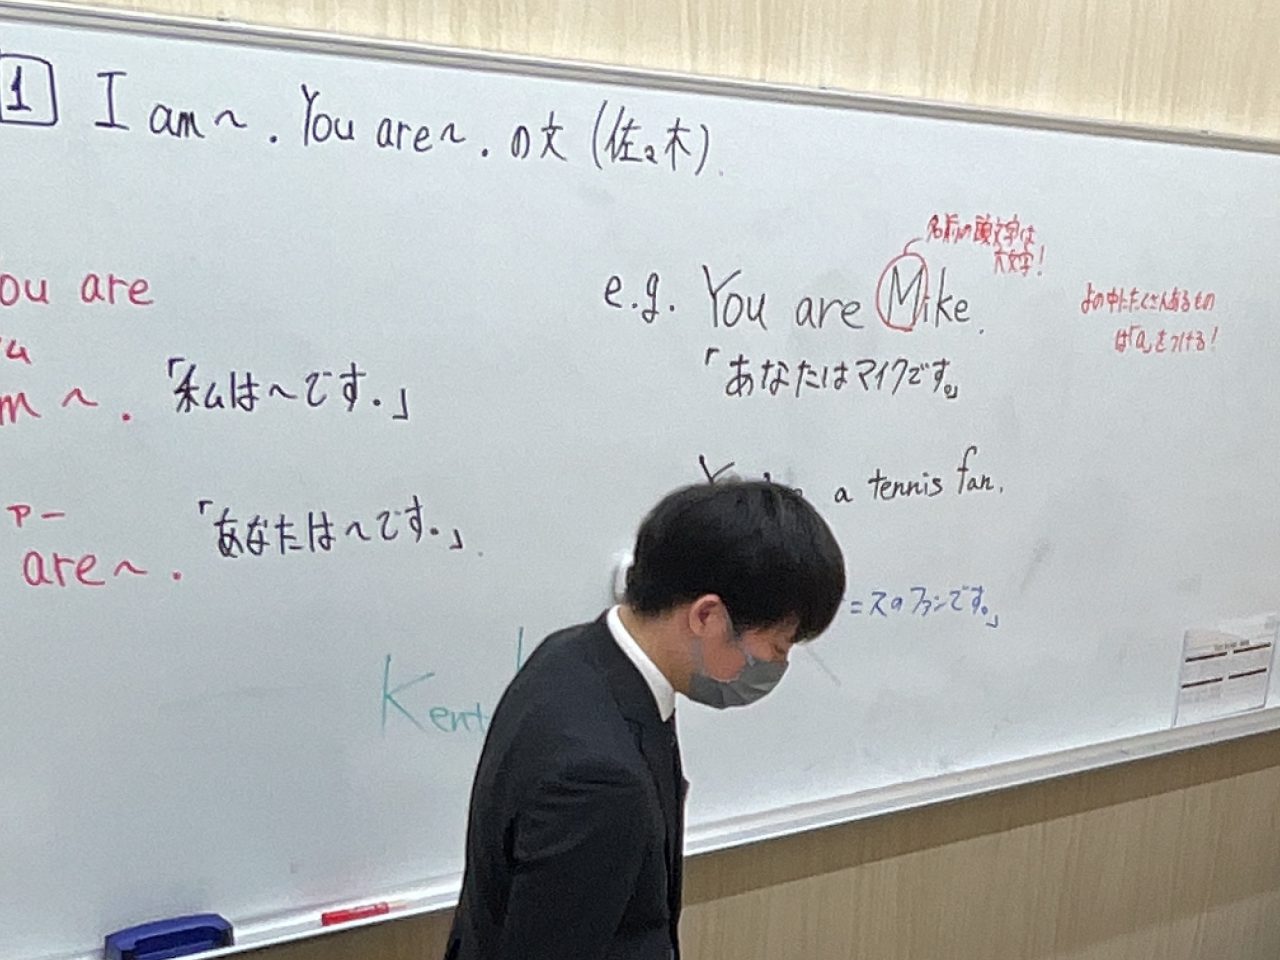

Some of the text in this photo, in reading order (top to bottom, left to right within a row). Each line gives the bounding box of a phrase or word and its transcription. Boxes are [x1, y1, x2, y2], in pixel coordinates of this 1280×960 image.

[7, 65, 32, 112] 1
[95, 71, 129, 130] I
[300, 83, 355, 146] You
[81, 273, 154, 305] are
[604, 272, 675, 323] e.g.
[702, 264, 768, 330] You
[795, 297, 864, 329] are
[833, 484, 854, 503] a
[867, 467, 944, 502] tennis
